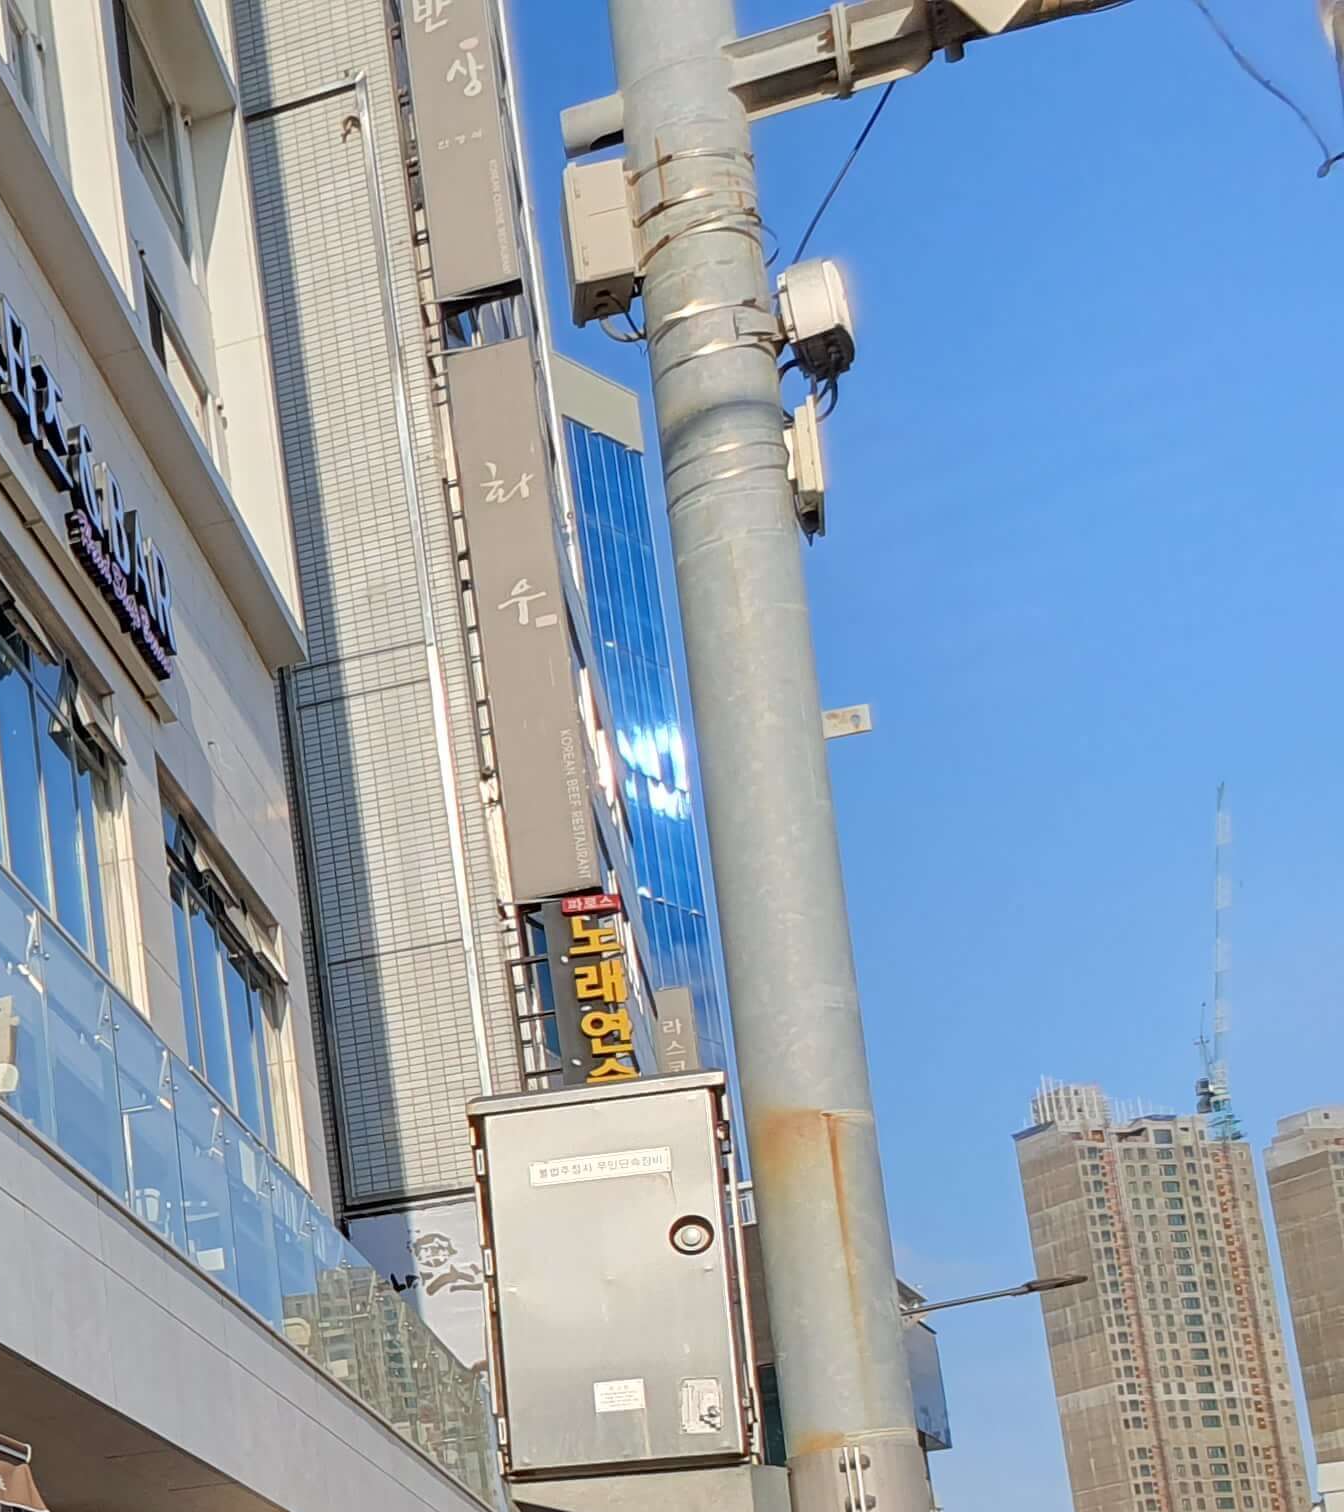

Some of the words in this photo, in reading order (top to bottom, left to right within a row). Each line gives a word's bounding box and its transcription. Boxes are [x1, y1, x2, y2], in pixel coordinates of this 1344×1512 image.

[559, 729, 576, 783] KOREAN
[565, 786, 581, 815] BEEF
[569, 818, 592, 880] RESTAURANT
[567, 897, 614, 911] 파로스
